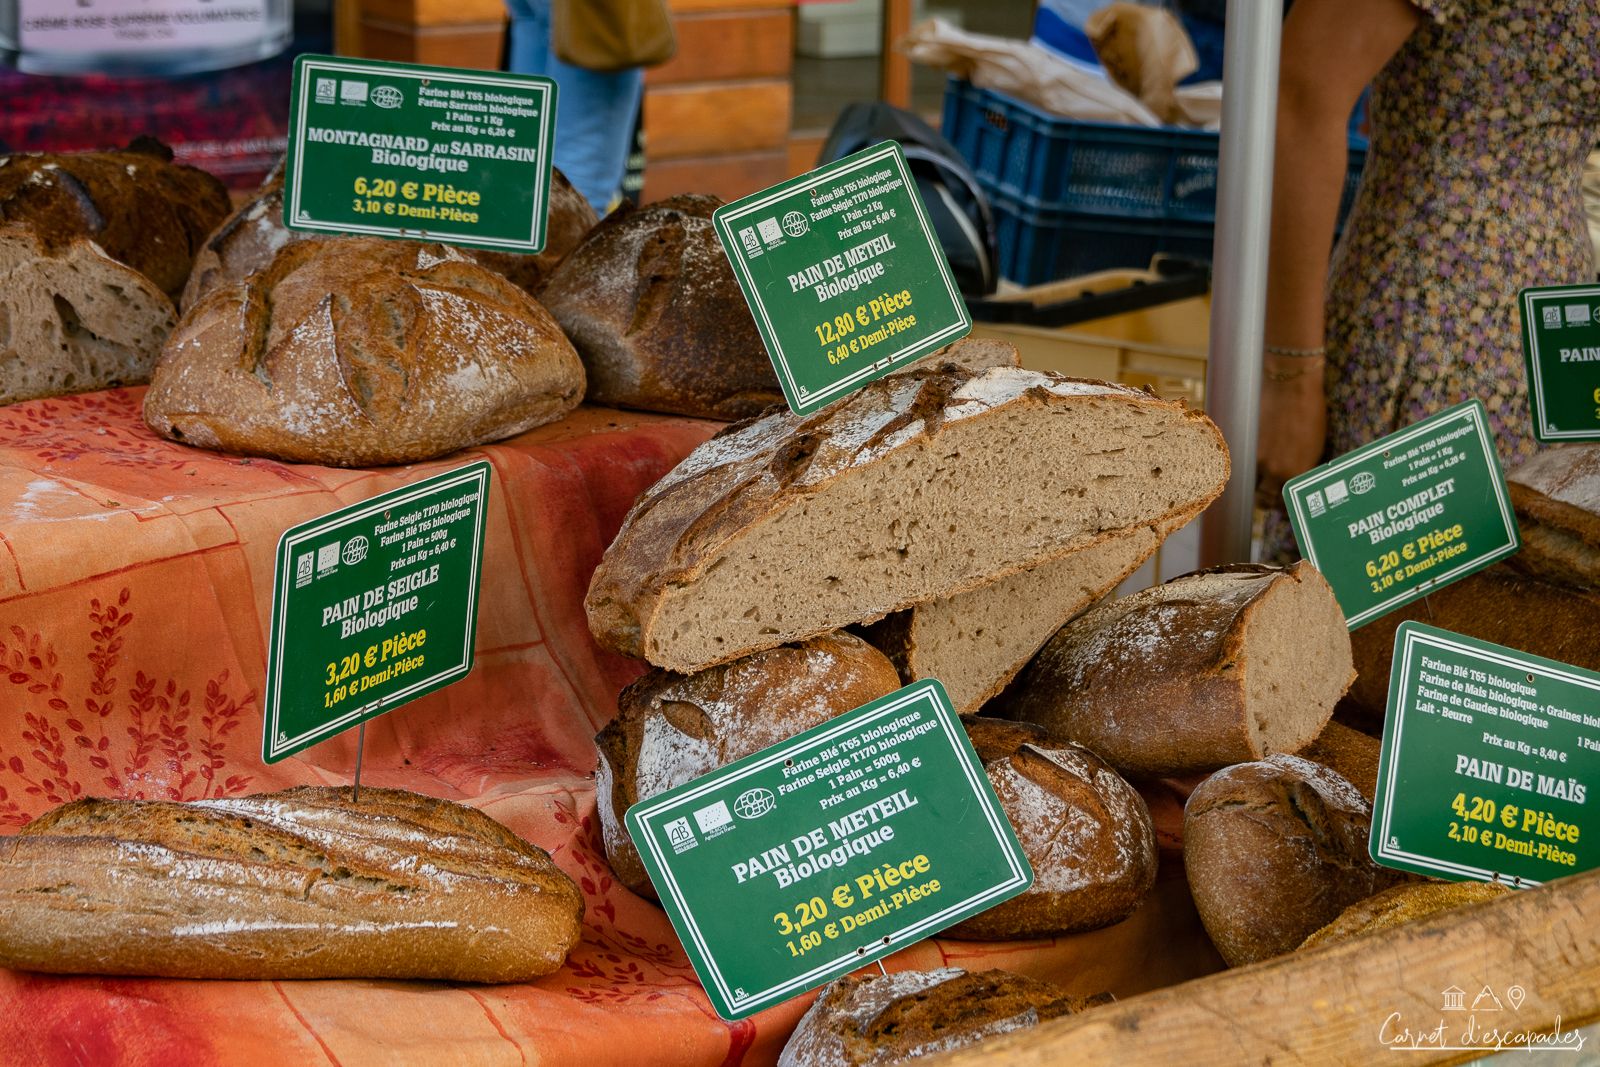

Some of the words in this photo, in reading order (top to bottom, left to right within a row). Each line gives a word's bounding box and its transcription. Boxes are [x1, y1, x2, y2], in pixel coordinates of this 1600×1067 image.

[308, 127, 429, 152] MONTAGNARD
[432, 143, 449, 154] AU
[450, 141, 536, 162] SARRASIN
[371, 148, 468, 173] Biologique
[354, 177, 397, 198] 6,20
[401, 182, 419, 200] €
[423, 183, 480, 206] Pièce
[809, 207, 833, 222] Farine
[831, 198, 854, 213] Seigle
[851, 191, 869, 204] T170
[867, 178, 903, 198] biologique
[810, 193, 834, 208] Farine
[832, 186, 845, 199] Blé
[843, 181, 858, 194] T65
[856, 169, 892, 189] biologique
[353, 199, 381, 214] 3,10
[383, 202, 396, 215] €
[398, 203, 479, 223] Demi-Pièce
[837, 228, 854, 240] Prix
[852, 224, 862, 234] au
[860, 220, 872, 230] Kg
[876, 211, 890, 224] 6,40
[842, 214, 848, 224] 1
[846, 209, 863, 222] Pain
[867, 204, 874, 213] 2
[871, 201, 884, 211] Kg
[787, 263, 824, 293] PAIN
[822, 254, 846, 277] DE
[843, 233, 896, 268] METEIL
[814, 262, 885, 303] Biologique
[814, 312, 855, 346] 12,80
[855, 305, 870, 326] €
[868, 290, 912, 321] Pièce
[827, 344, 849, 365] 6,40
[849, 338, 860, 353] €
[858, 314, 917, 350] Demi-Pièce
[1560, 347, 1600, 363] PAIN
[374, 520, 399, 536] Farine
[399, 511, 422, 526] Seigle
[422, 504, 440, 518] T170
[440, 492, 479, 512] biologique
[380, 531, 405, 547] Farine
[405, 524, 418, 538] Blé
[418, 519, 432, 533] T65
[432, 508, 471, 528] biologique
[1348, 511, 1385, 538] PAIN
[1387, 478, 1454, 520] COMPLET
[1368, 502, 1444, 544] Biologique
[390, 558, 406, 571] Prix
[406, 554, 416, 565] au
[417, 550, 428, 561] Kg
[434, 540, 449, 554] 6,40
[402, 543, 406, 553] 1
[407, 537, 424, 551] Pain
[430, 529, 448, 542] 500g
[1366, 550, 1400, 577] 6,20
[1401, 542, 1416, 560] €
[1417, 524, 1463, 554] Pièce
[1371, 574, 1394, 593] 3,10
[1394, 569, 1405, 581] €
[1404, 542, 1467, 577] Demi-Pièce
[322, 594, 360, 627] PAIN
[362, 585, 385, 610] DE
[387, 564, 440, 600] SEIGLE
[340, 595, 418, 639] Biologique
[325, 652, 360, 686] 3,20
[364, 644, 378, 668] €
[380, 629, 426, 662] Pièce
[1421, 656, 1452, 674] Farine
[1453, 665, 1468, 678] Blé
[1469, 669, 1486, 683] T65
[1488, 674, 1537, 697] biologique
[324, 685, 347, 708] 1,60
[349, 680, 359, 696] €
[360, 654, 424, 692] Demi-Pièce
[1419, 670, 1450, 688] Farine
[1451, 680, 1464, 692] de
[1488, 689, 1538, 711] biologique
[1546, 705, 1582, 723] Graines
[1415, 699, 1435, 714] Lait
[1441, 706, 1473, 724] Beurre
[1417, 685, 1449, 703] Farine
[1449, 694, 1462, 706] de
[1463, 697, 1498, 716] Gaudes
[1499, 706, 1549, 729] biologique
[777, 774, 816, 796] Farine
[815, 758, 851, 779] Seigle
[850, 745, 877, 763] T170
[877, 719, 938, 751] biologique
[782, 757, 820, 778] Farine
[819, 746, 839, 762] Blé
[838, 736, 861, 752] T65
[860, 712, 921, 743] biologique
[1482, 732, 1503, 747] Prix
[1503, 739, 1516, 750] au
[1517, 741, 1531, 755] Kg
[1539, 747, 1558, 760] 8,40
[819, 793, 846, 810] Prix
[845, 786, 861, 798] au
[860, 778, 878, 792] Kg
[888, 762, 910, 779] 6,40
[911, 757, 922, 768] €
[828, 779, 836, 789] 1
[836, 769, 864, 786] Pain
[872, 752, 901, 769] 500g
[1455, 754, 1504, 784] PAIN
[1506, 767, 1534, 791] DE
[1536, 774, 1586, 804] MAÏS
[731, 843, 791, 884] PAIN
[791, 827, 828, 857] DE
[827, 789, 918, 841] METEIL
[1451, 792, 1496, 823] 4,20
[1500, 804, 1519, 828] €
[1521, 808, 1580, 843] Pièce
[773, 825, 894, 889] Biologique
[1448, 822, 1478, 843] 2,10
[1480, 830, 1493, 846] €
[1494, 832, 1576, 866] Demi-Pièce
[774, 896, 828, 935] 3,20
[831, 883, 854, 908] €
[854, 854, 930, 899] Pièce
[786, 930, 822, 957] 1,60
[824, 922, 839, 939] €
[839, 879, 941, 933] Demi-Pièce
